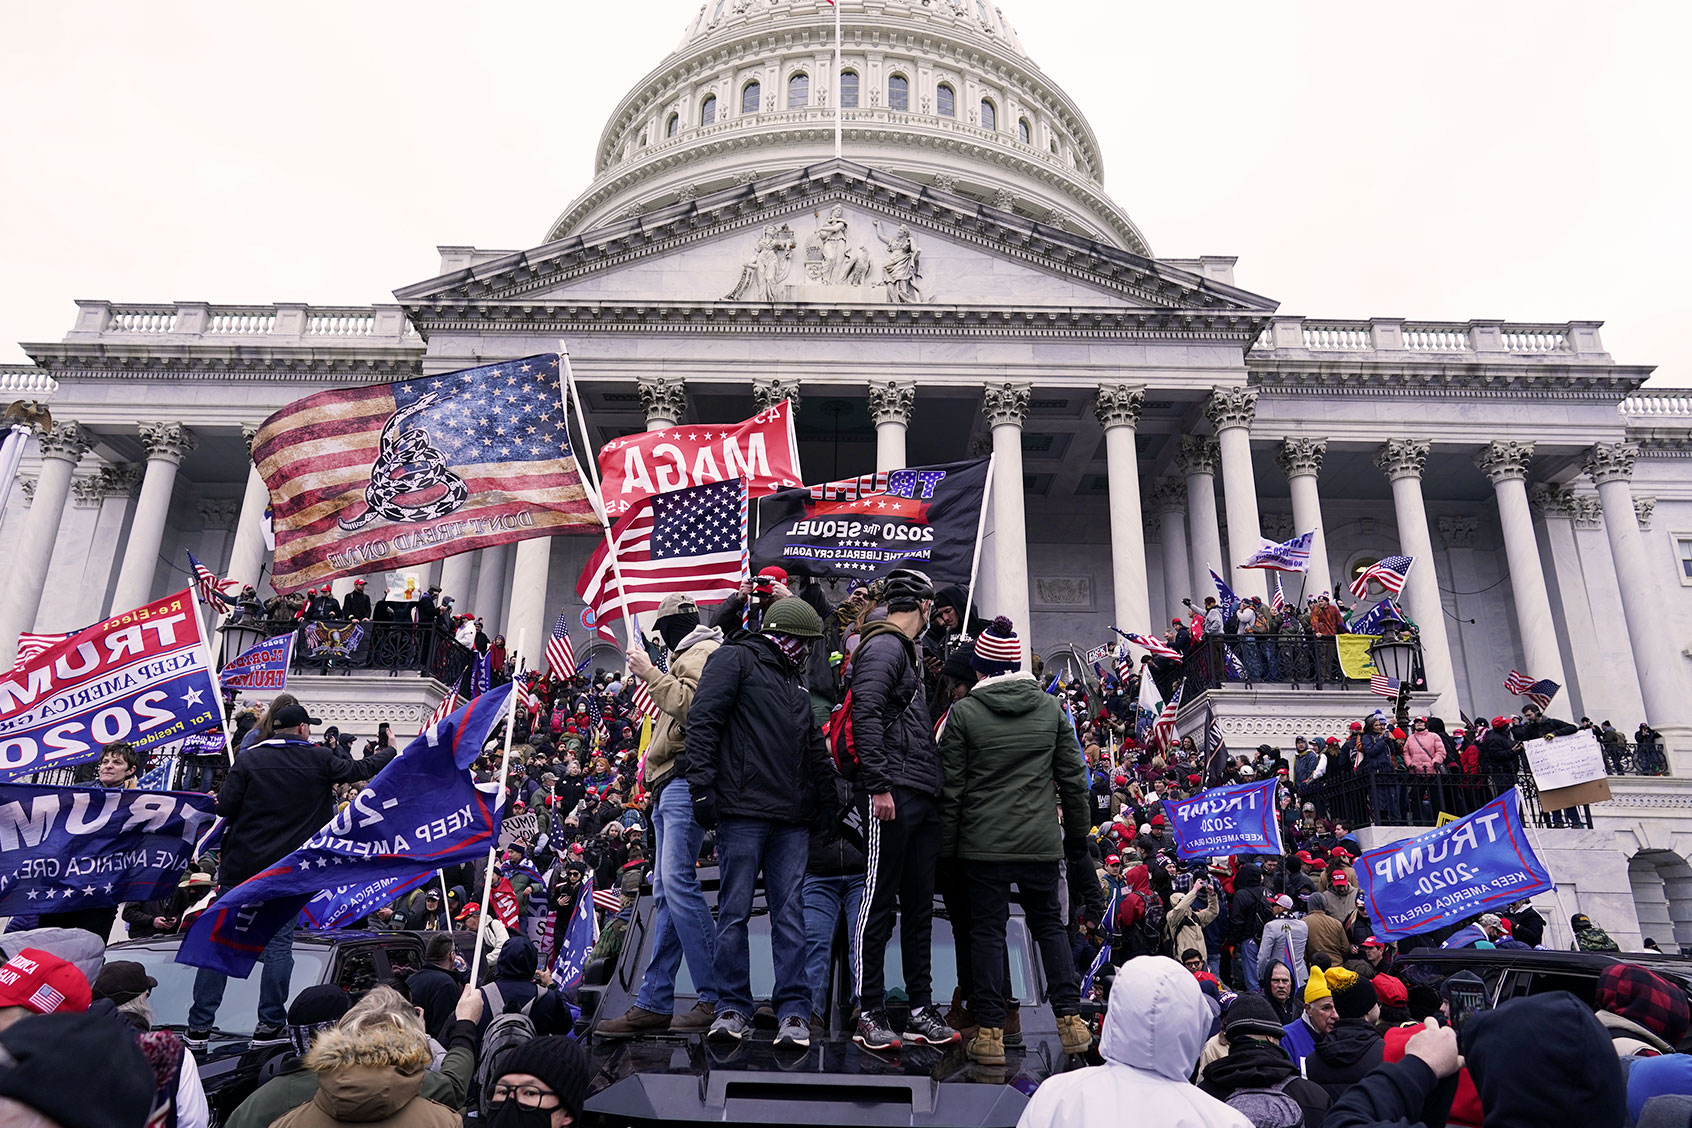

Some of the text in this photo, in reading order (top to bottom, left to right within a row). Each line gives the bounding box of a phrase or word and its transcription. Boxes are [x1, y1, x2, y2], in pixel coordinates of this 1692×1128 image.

[501, 814, 536, 833] RUMP
[7, 953, 40, 975] MERICA
[0, 967, 21, 986] GAIN
